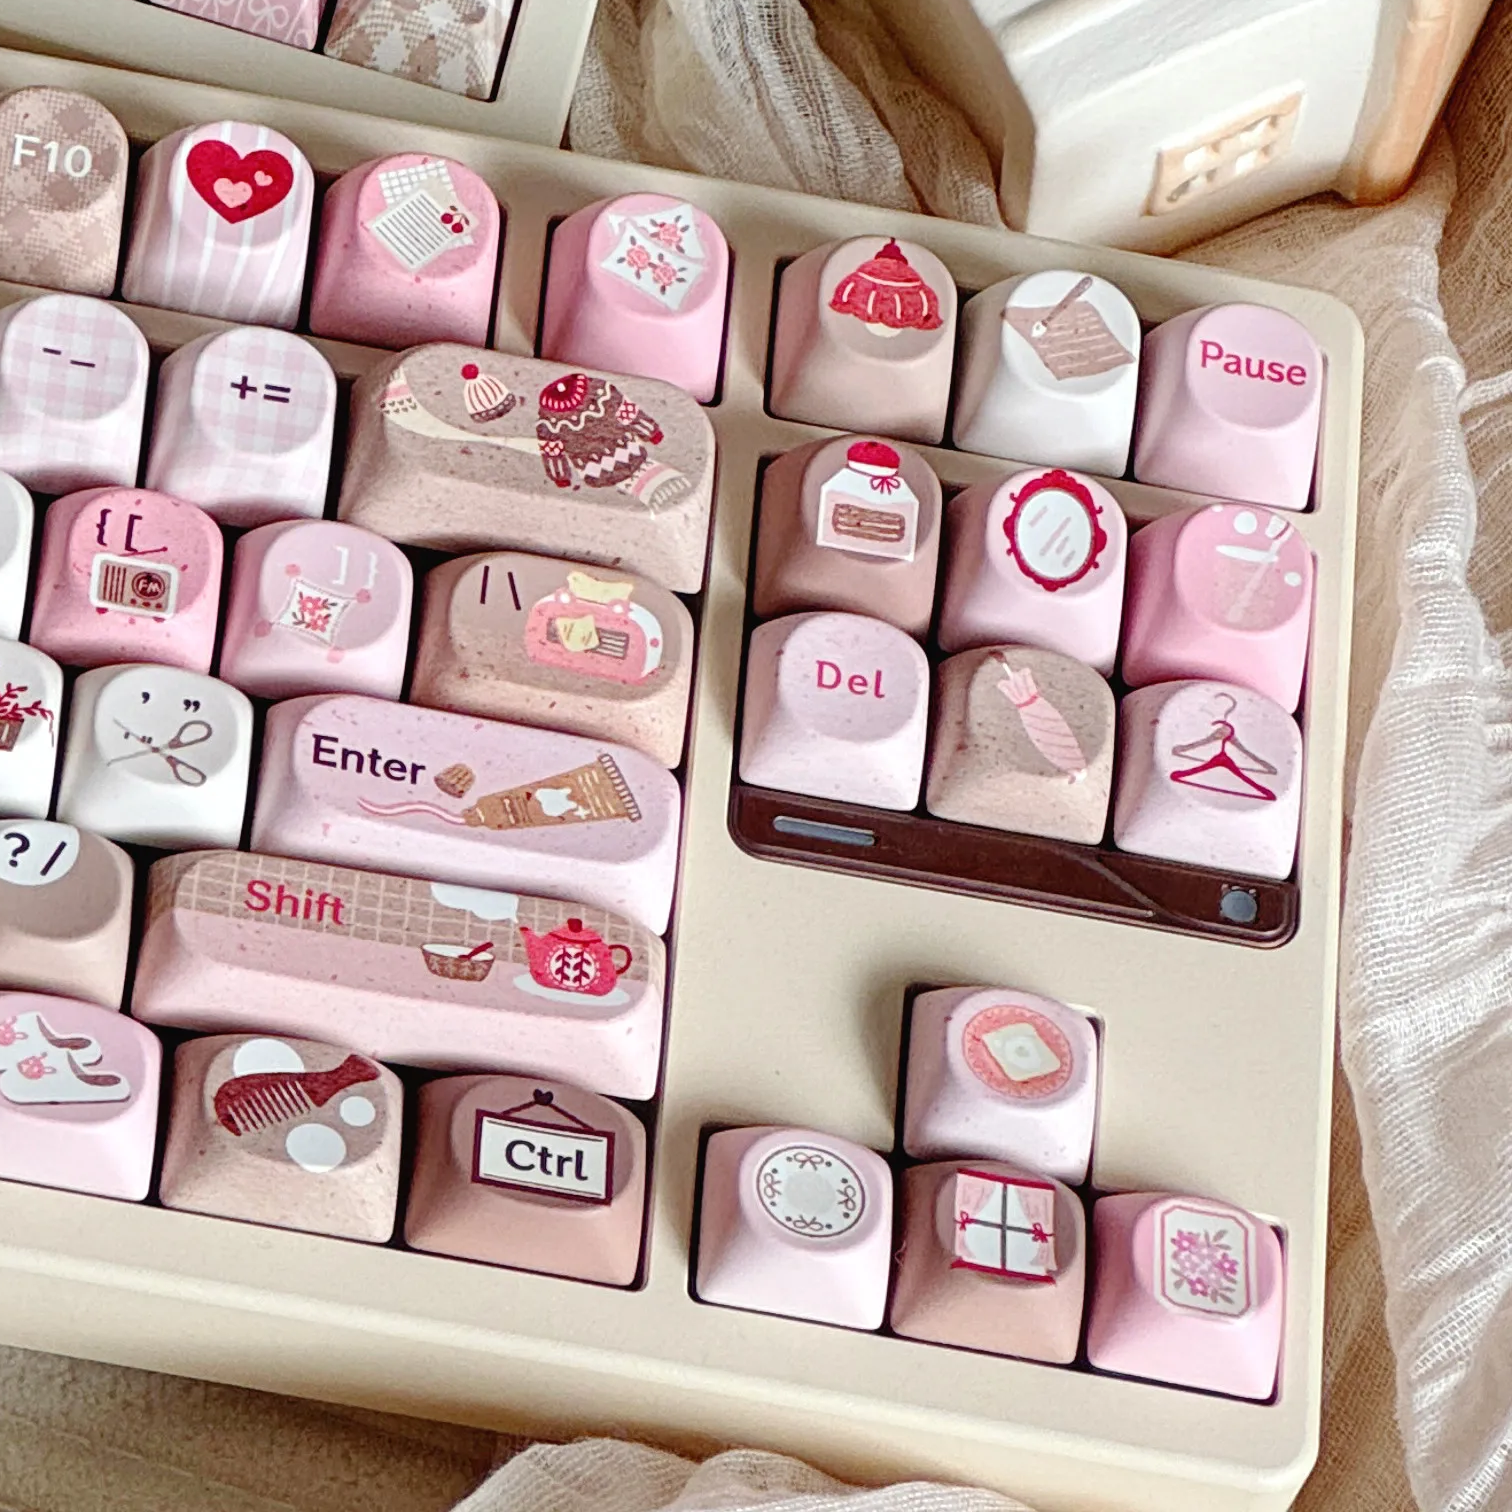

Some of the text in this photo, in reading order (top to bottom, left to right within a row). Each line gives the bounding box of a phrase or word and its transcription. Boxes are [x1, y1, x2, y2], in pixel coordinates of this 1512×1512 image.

[11, 134, 92, 177] F10
[1198, 339, 1309, 387] Pause
[815, 660, 886, 700] Del
[311, 734, 427, 785] Enter
[244, 879, 347, 927] Shift
[504, 1139, 589, 1182] Ctrl
